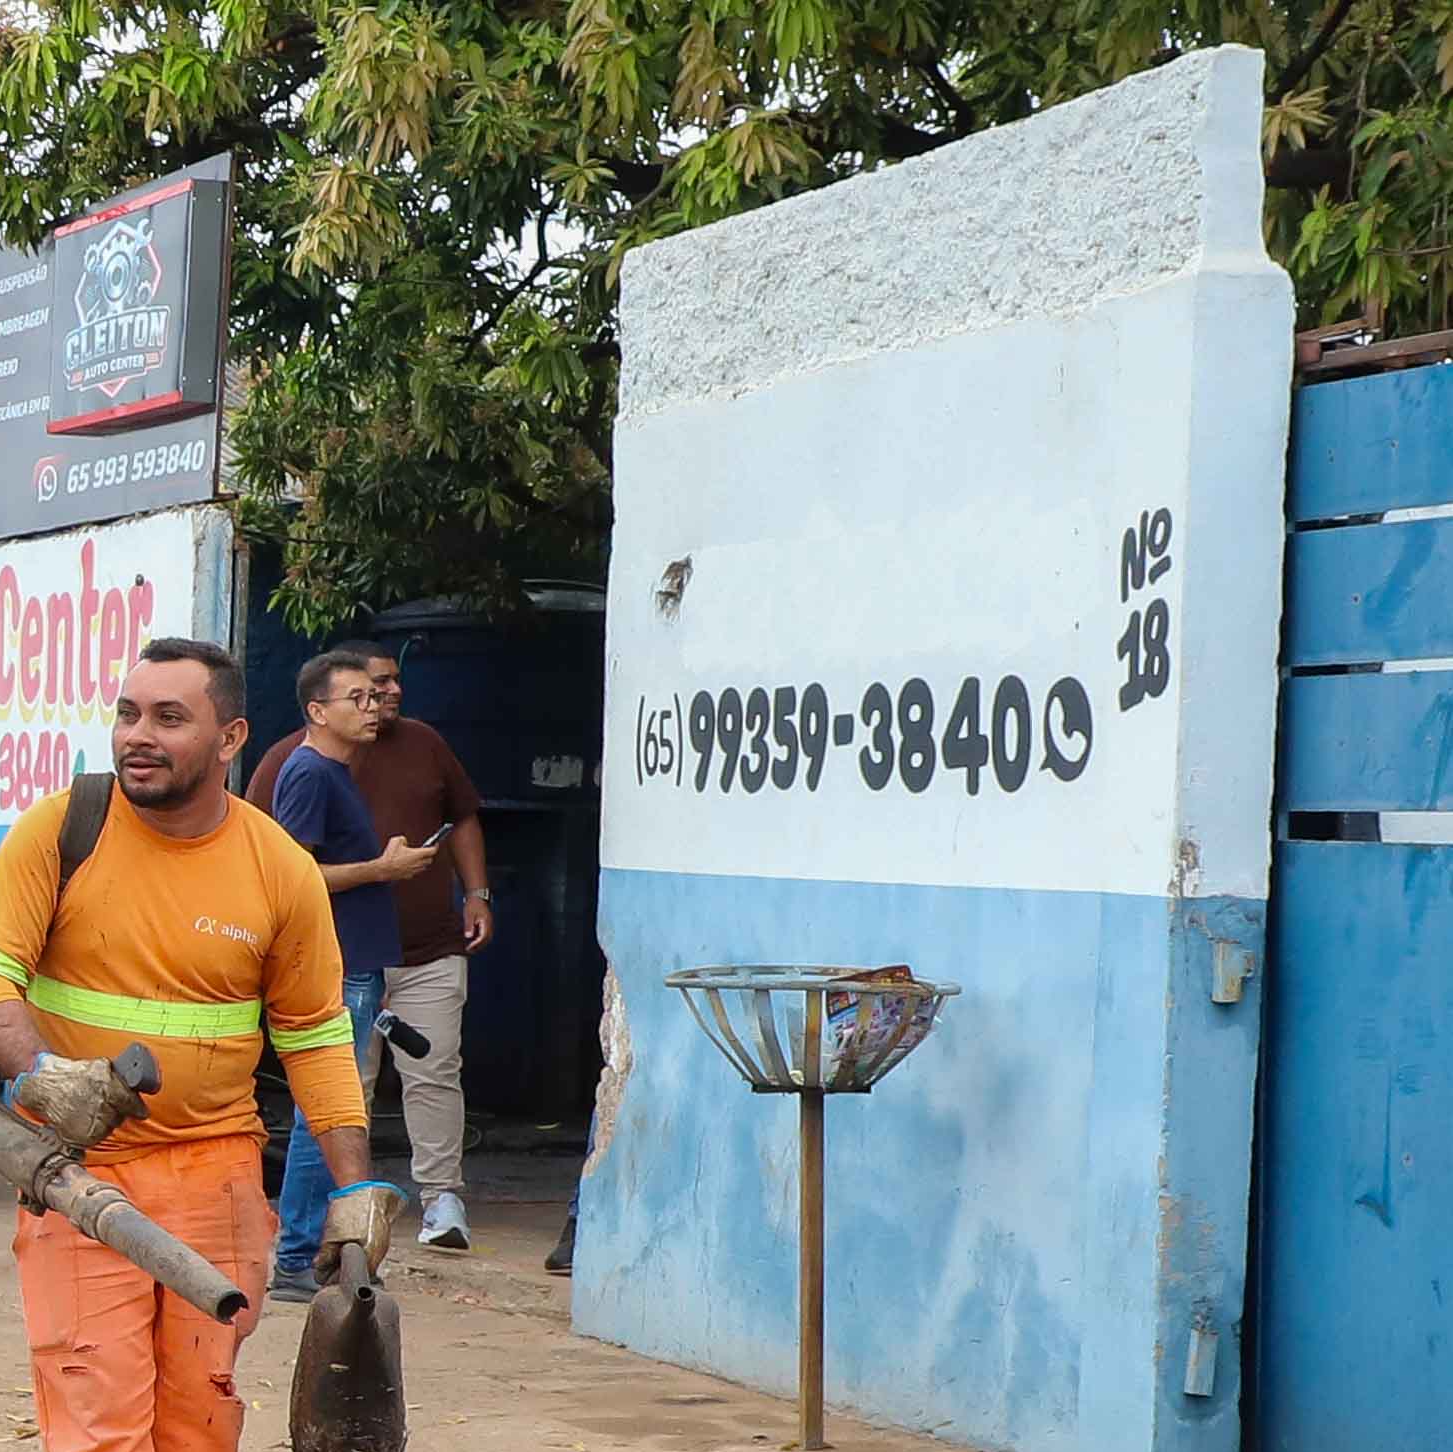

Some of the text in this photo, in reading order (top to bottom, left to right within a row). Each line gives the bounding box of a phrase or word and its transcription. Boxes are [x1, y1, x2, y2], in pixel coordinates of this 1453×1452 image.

[66, 311, 168, 371] CLEITON
[84, 354, 145, 380] AUTO CENTER
[67, 439, 206, 494] 65 993 593840
[1117, 597, 1171, 712] 18
[636, 675, 1033, 797] (65) 99359-3840
[221, 923, 258, 945] alpha
